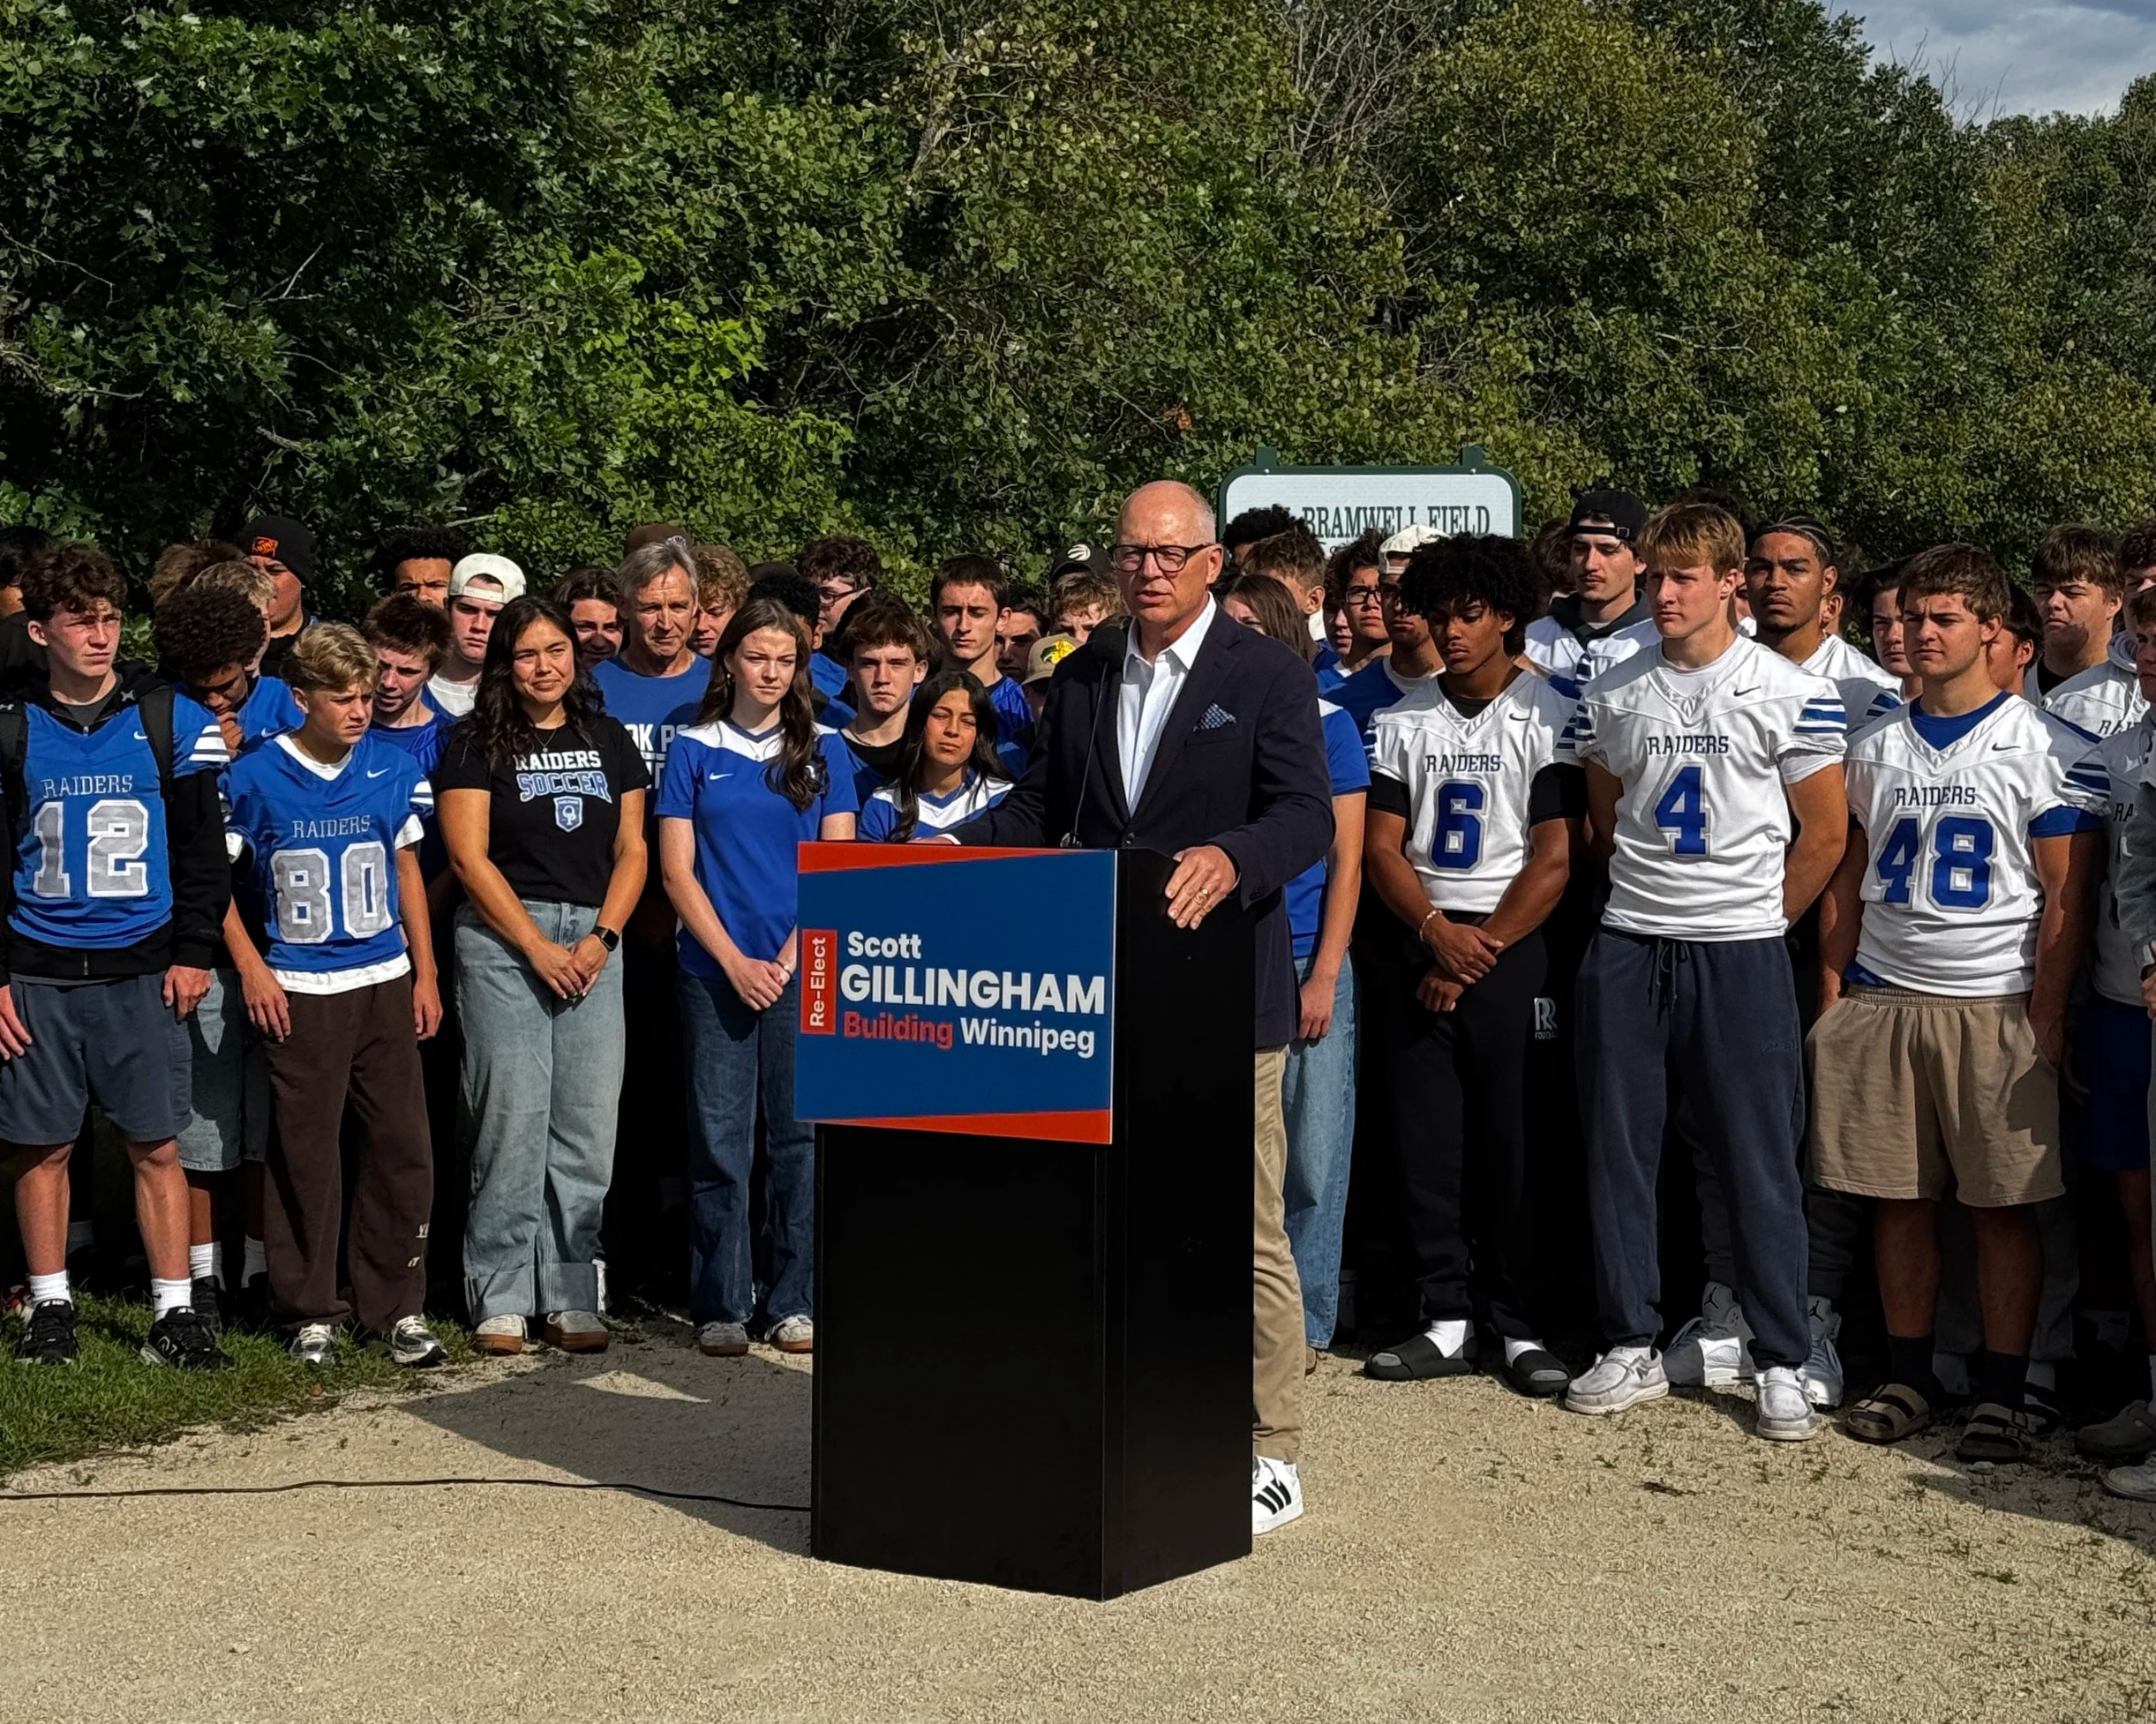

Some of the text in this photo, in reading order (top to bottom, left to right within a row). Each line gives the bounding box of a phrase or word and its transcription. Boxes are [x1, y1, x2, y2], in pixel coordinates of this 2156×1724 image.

[1427, 505, 1490, 537] FIELD
[513, 750, 602, 771] RAIDERS
[1644, 735, 1729, 755] RAIDERS
[1424, 753, 1501, 773] RAIDERS
[41, 775, 132, 798] RAIDERS
[516, 770, 612, 803] SOCCER
[1895, 785, 1976, 806] RAIDERS
[291, 814, 371, 838] RAIDERS
[1427, 778, 1489, 874] 6
[1653, 761, 1711, 859] 4
[33, 799, 148, 898] 12
[1874, 811, 1998, 915] 48
[270, 841, 394, 943] 80
[847, 931, 922, 959] Scott
[809, 936, 827, 1027] Re-Elect
[840, 963, 1105, 1015] GILLINGHAM
[844, 1011, 1094, 1059] Building Winnipeg
